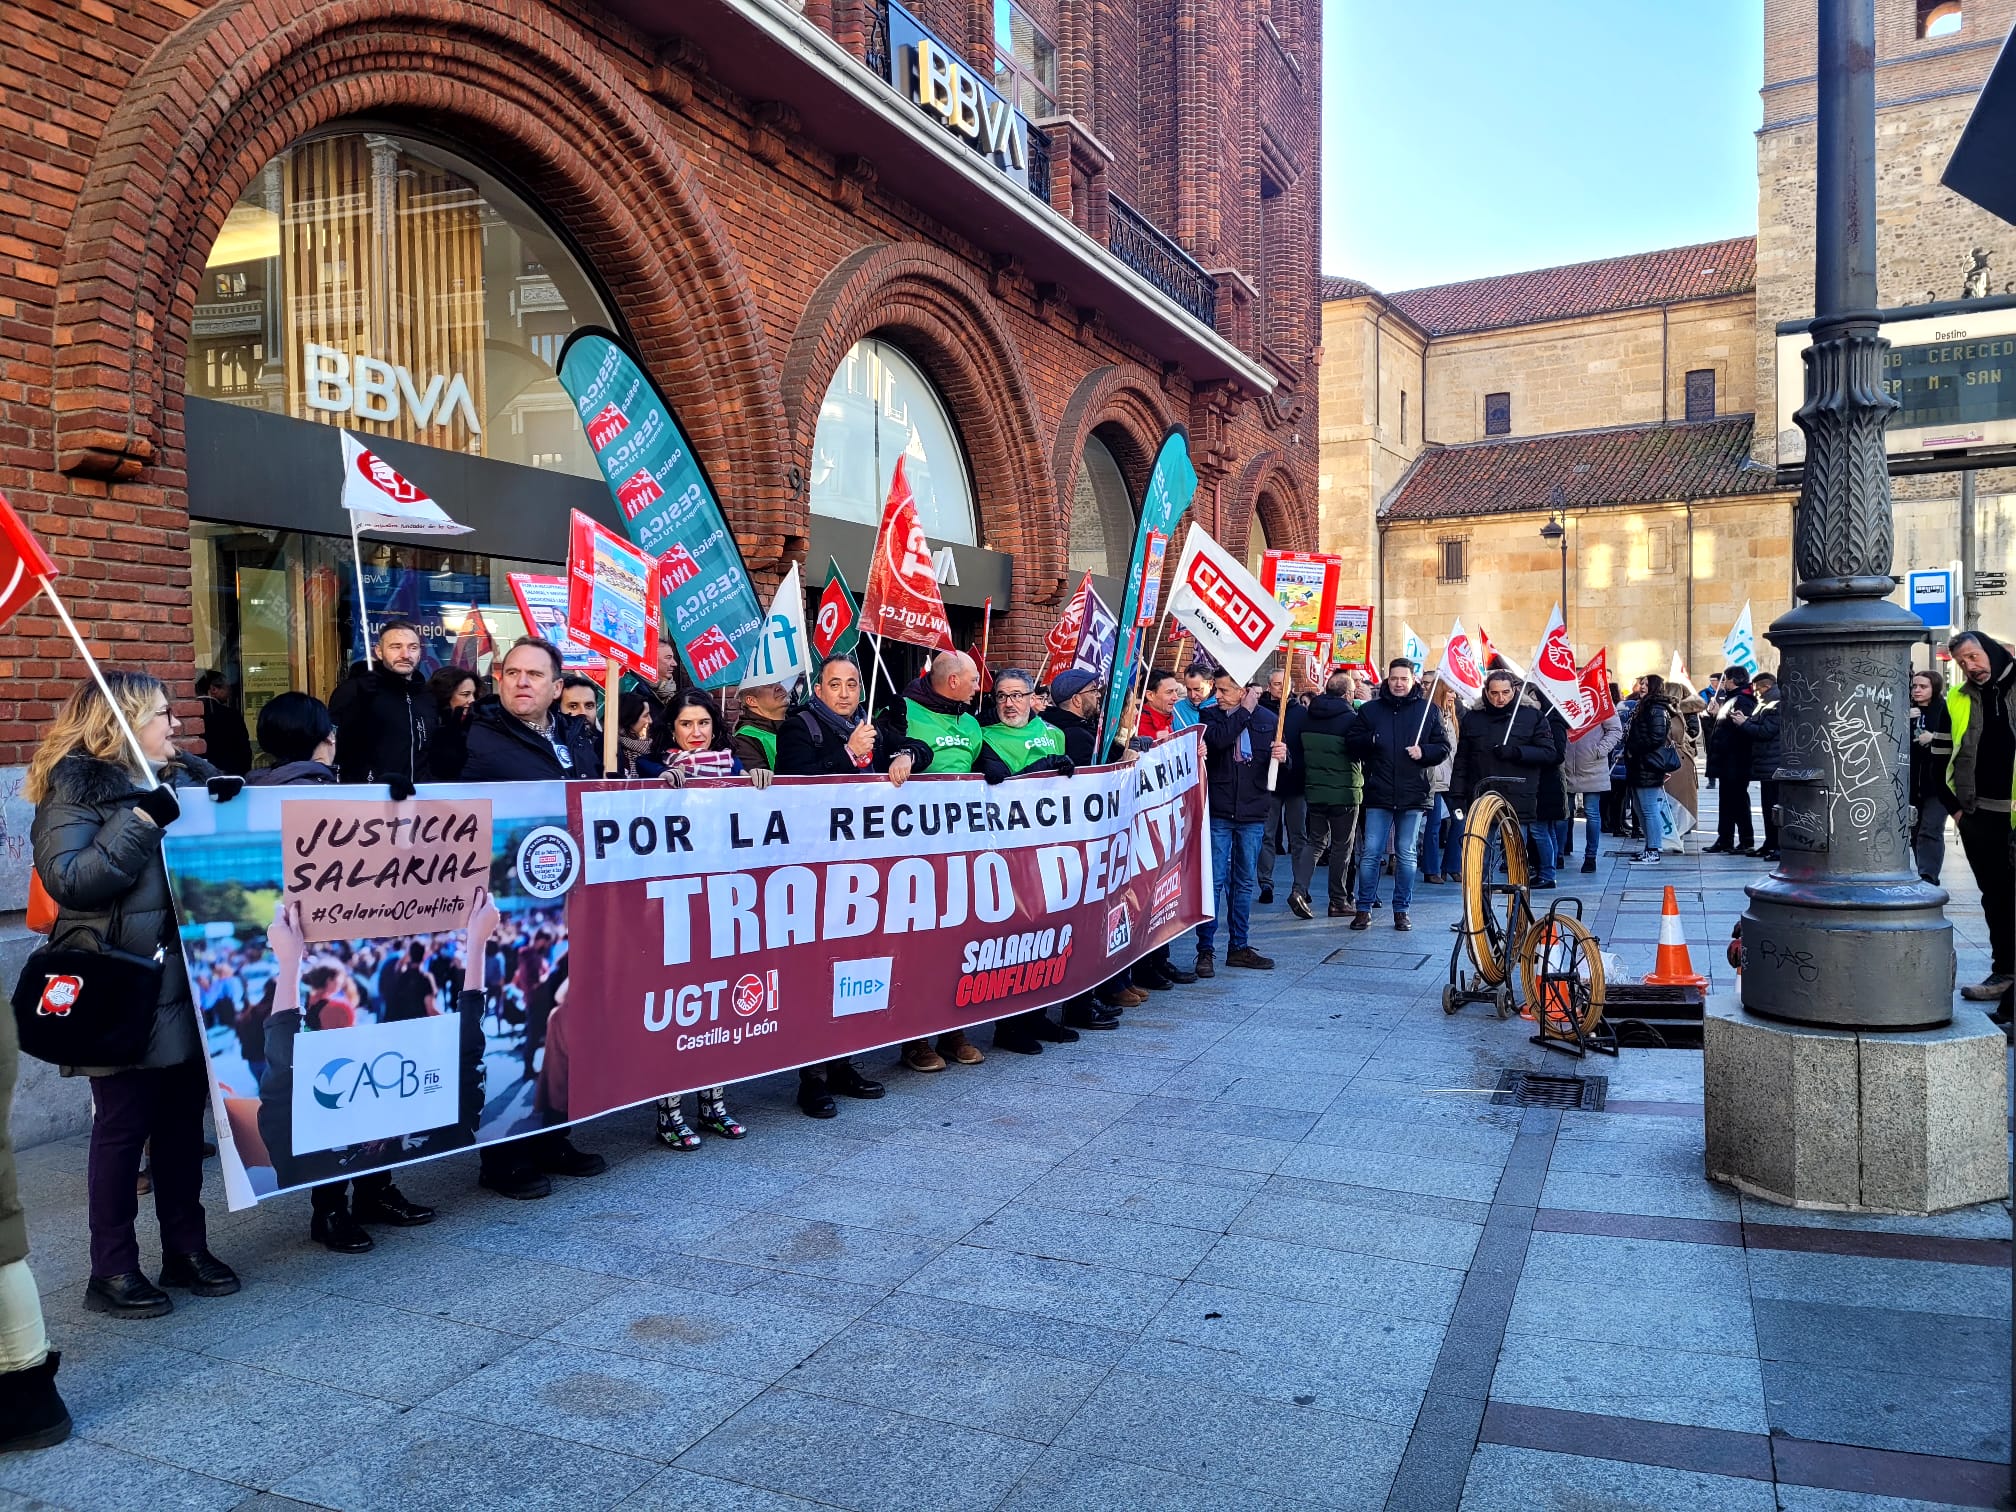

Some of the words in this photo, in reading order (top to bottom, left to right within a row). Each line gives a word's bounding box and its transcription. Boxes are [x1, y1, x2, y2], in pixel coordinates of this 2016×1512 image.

[917, 38, 1025, 170] BBVA
[1936, 329, 1967, 341] Destino
[1882, 353, 1911, 368] OB.
[1882, 379, 1912, 394] SP.
[1966, 369, 2001, 386] SAN
[304, 342, 481, 434] BBVA
[1193, 560, 1267, 642] CCOO
[1194, 608, 1220, 636] León
[295, 813, 479, 858] JUSTICIA
[593, 816, 694, 859] POR
[729, 810, 790, 849] LA
[829, 790, 1120, 841] RECUPERACION
[287, 851, 489, 893] SALARIAL
[646, 852, 1016, 966] TRABAJO
[1036, 795, 1186, 913] DECNTE
[311, 896, 465, 924] #SalarioOConflicto
[961, 927, 1056, 974] SALARIO
[955, 955, 1069, 1008] CONFLICTO
[643, 980, 728, 1032] UGT
[676, 1026, 730, 1051] Castilla
[733, 1030, 742, 1045] y
[745, 1018, 778, 1039] León
